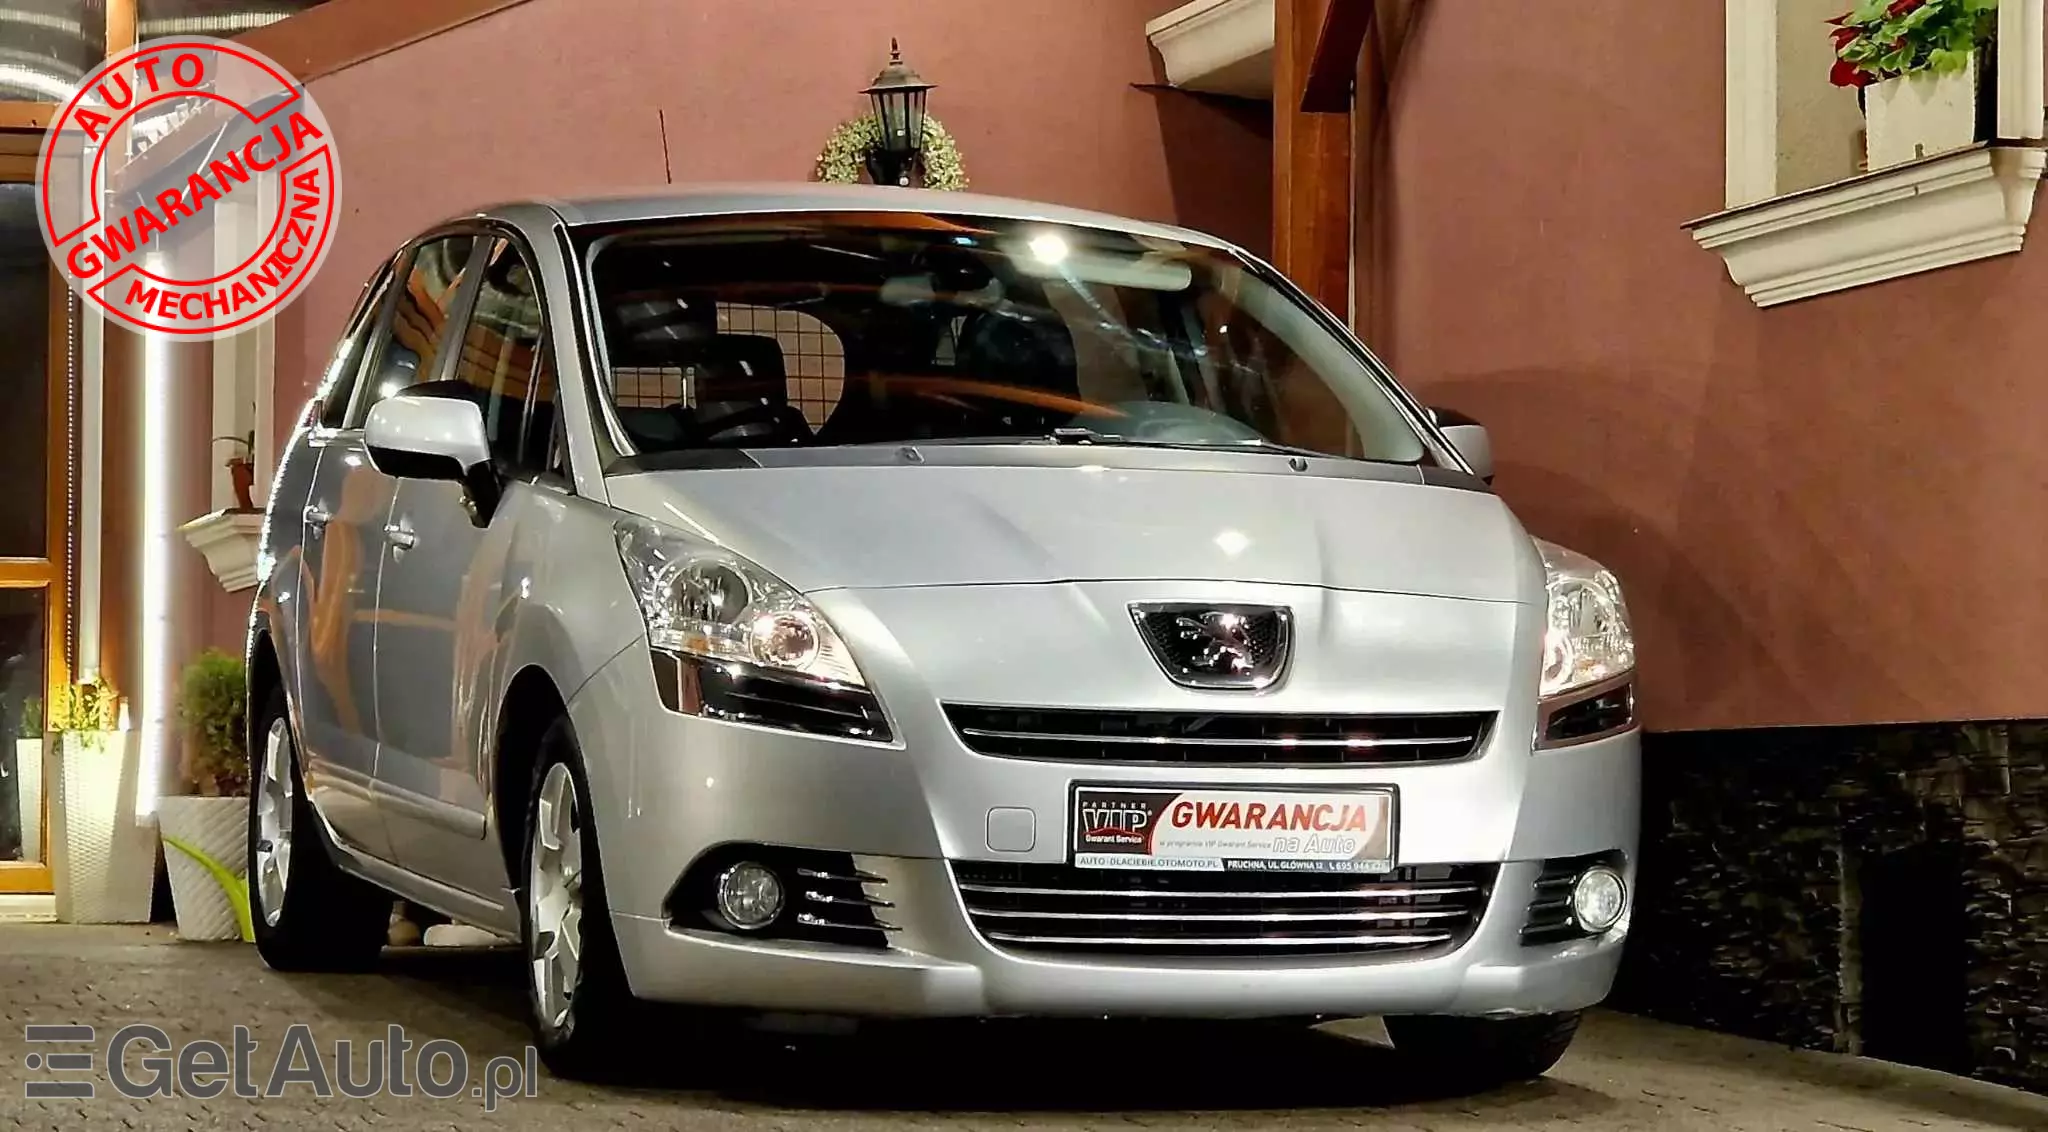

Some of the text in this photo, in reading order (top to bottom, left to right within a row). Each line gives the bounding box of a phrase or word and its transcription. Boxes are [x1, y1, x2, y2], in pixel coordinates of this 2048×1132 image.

[1082, 801, 1147, 810] PARTNER
[1171, 801, 1367, 831] GWARANCJA
[1082, 808, 1147, 833] VIP
[1085, 834, 1142, 844] Gwarant Service
[1272, 833, 1356, 854] na Auto
